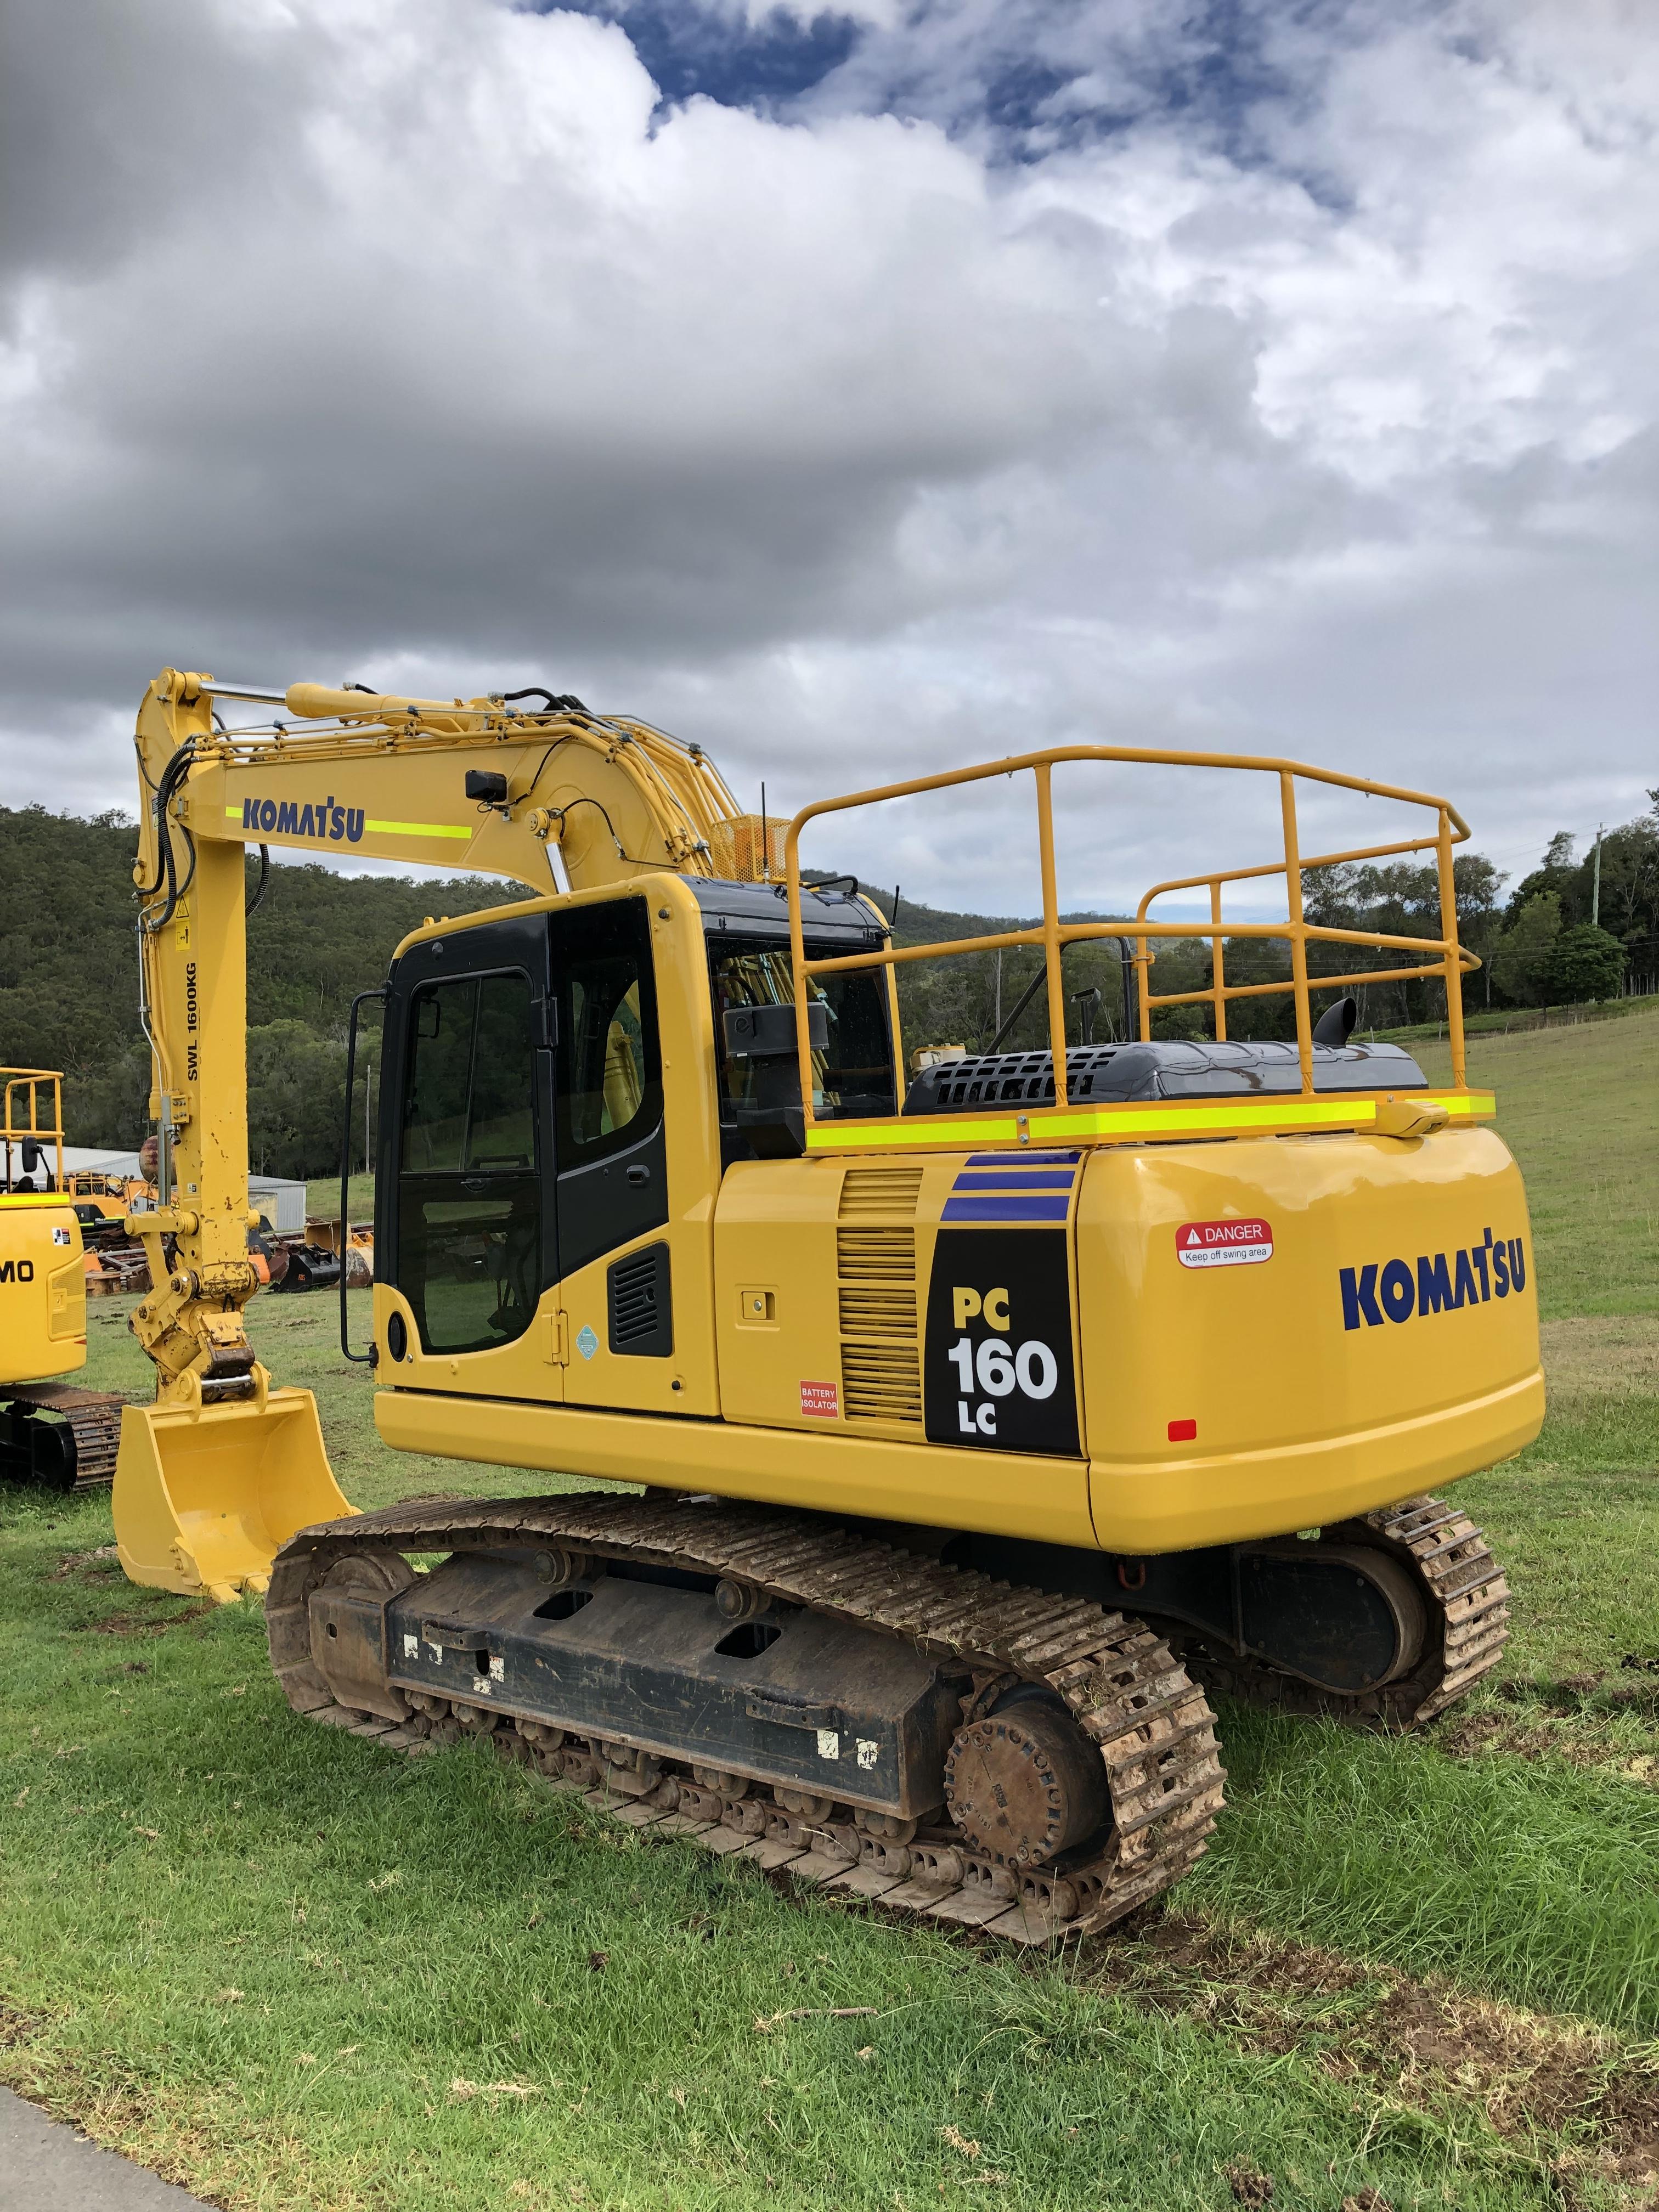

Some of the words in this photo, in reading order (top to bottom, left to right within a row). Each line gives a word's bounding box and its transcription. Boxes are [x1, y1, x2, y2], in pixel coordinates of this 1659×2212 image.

[242, 795, 365, 843] KOMATSU
[186, 962, 197, 1034] 1600KG
[188, 1040, 198, 1081] SWL
[1205, 1224, 1263, 1242] DANGER
[1186, 1252, 1208, 1262] Keep
[1210, 1250, 1221, 1260] off
[1223, 1249, 1246, 1259] swing
[1249, 1248, 1267, 1256] area
[1339, 1227, 1526, 1331] KOMATSU
[952, 1286, 1010, 1331] PC
[948, 1338, 1058, 1399] 160
[802, 1387, 835, 1398] BATTERY
[802, 1399, 837, 1410] ISOLATOR
[958, 1401, 996, 1435] LC
